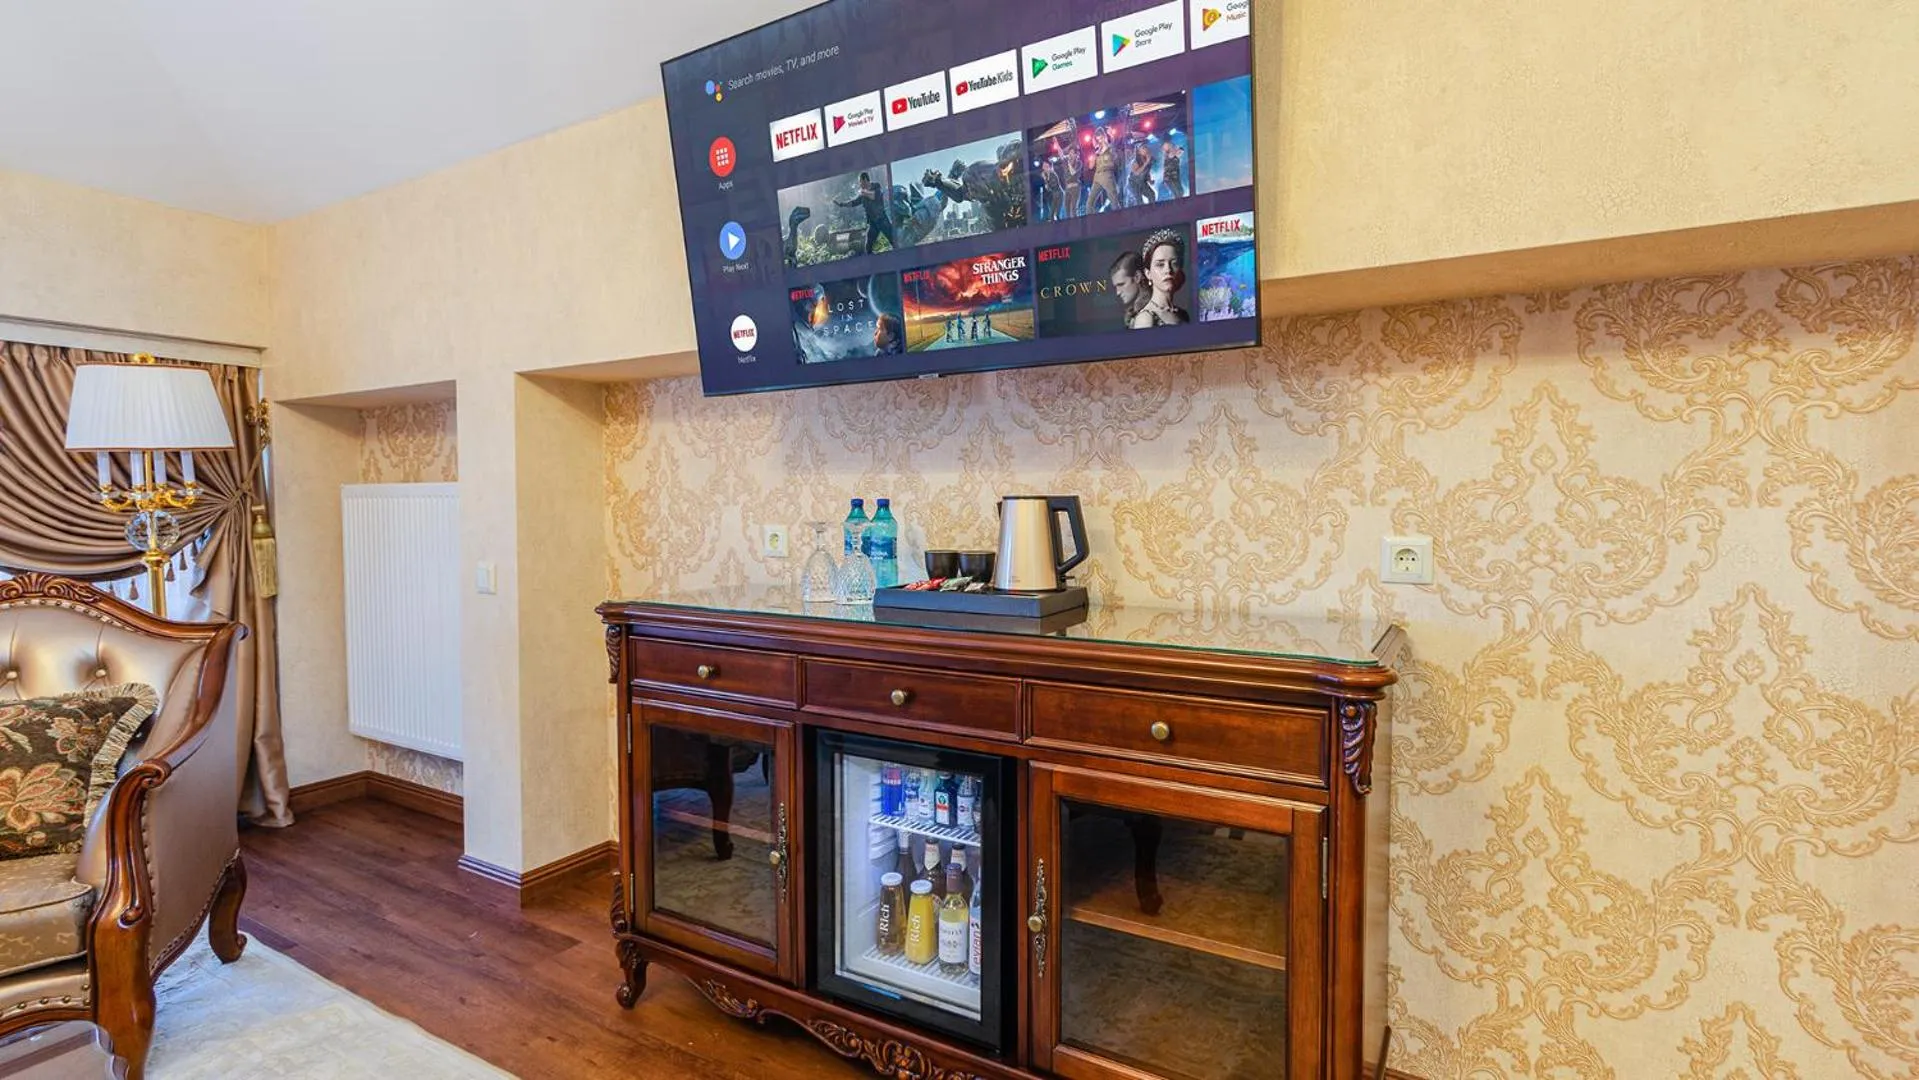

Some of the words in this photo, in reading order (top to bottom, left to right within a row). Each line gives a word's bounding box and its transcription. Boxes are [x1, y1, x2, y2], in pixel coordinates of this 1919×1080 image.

[1226, 11, 1247, 22] Music
[1134, 24, 1158, 38] Google
[1158, 22, 1173, 31] Play
[1135, 38, 1152, 48] Store
[1051, 50, 1073, 61] Google
[1073, 47, 1086, 56] Play
[728, 74, 754, 90] Search
[786, 58, 799, 72] TV,
[800, 51, 816, 66] and
[817, 45, 839, 60] more
[1052, 61, 1073, 71] Games
[968, 75, 997, 92] YouTube
[997, 70, 1013, 82] Kids
[907, 90, 941, 109] YouTube
[847, 111, 863, 120] Google
[776, 122, 818, 150] NETFLIX
[718, 180, 734, 191] Apps
[1202, 219, 1240, 237] NETFLIX
[1038, 247, 1071, 263] NETFLIX
[735, 262, 749, 271] Next
[972, 256, 1026, 275] STRANGER
[903, 271, 931, 283] NETFLIX
[981, 270, 1020, 285] THINGS
[790, 288, 816, 301] NETFLIX
[1040, 279, 1108, 299] CROWN
[827, 299, 865, 314] LOST
[733, 328, 755, 340] NETFLIX
[822, 320, 877, 337] SPACE
[737, 355, 757, 364] Netflix
[880, 904, 890, 933] Rich
[910, 914, 921, 943] Rich
